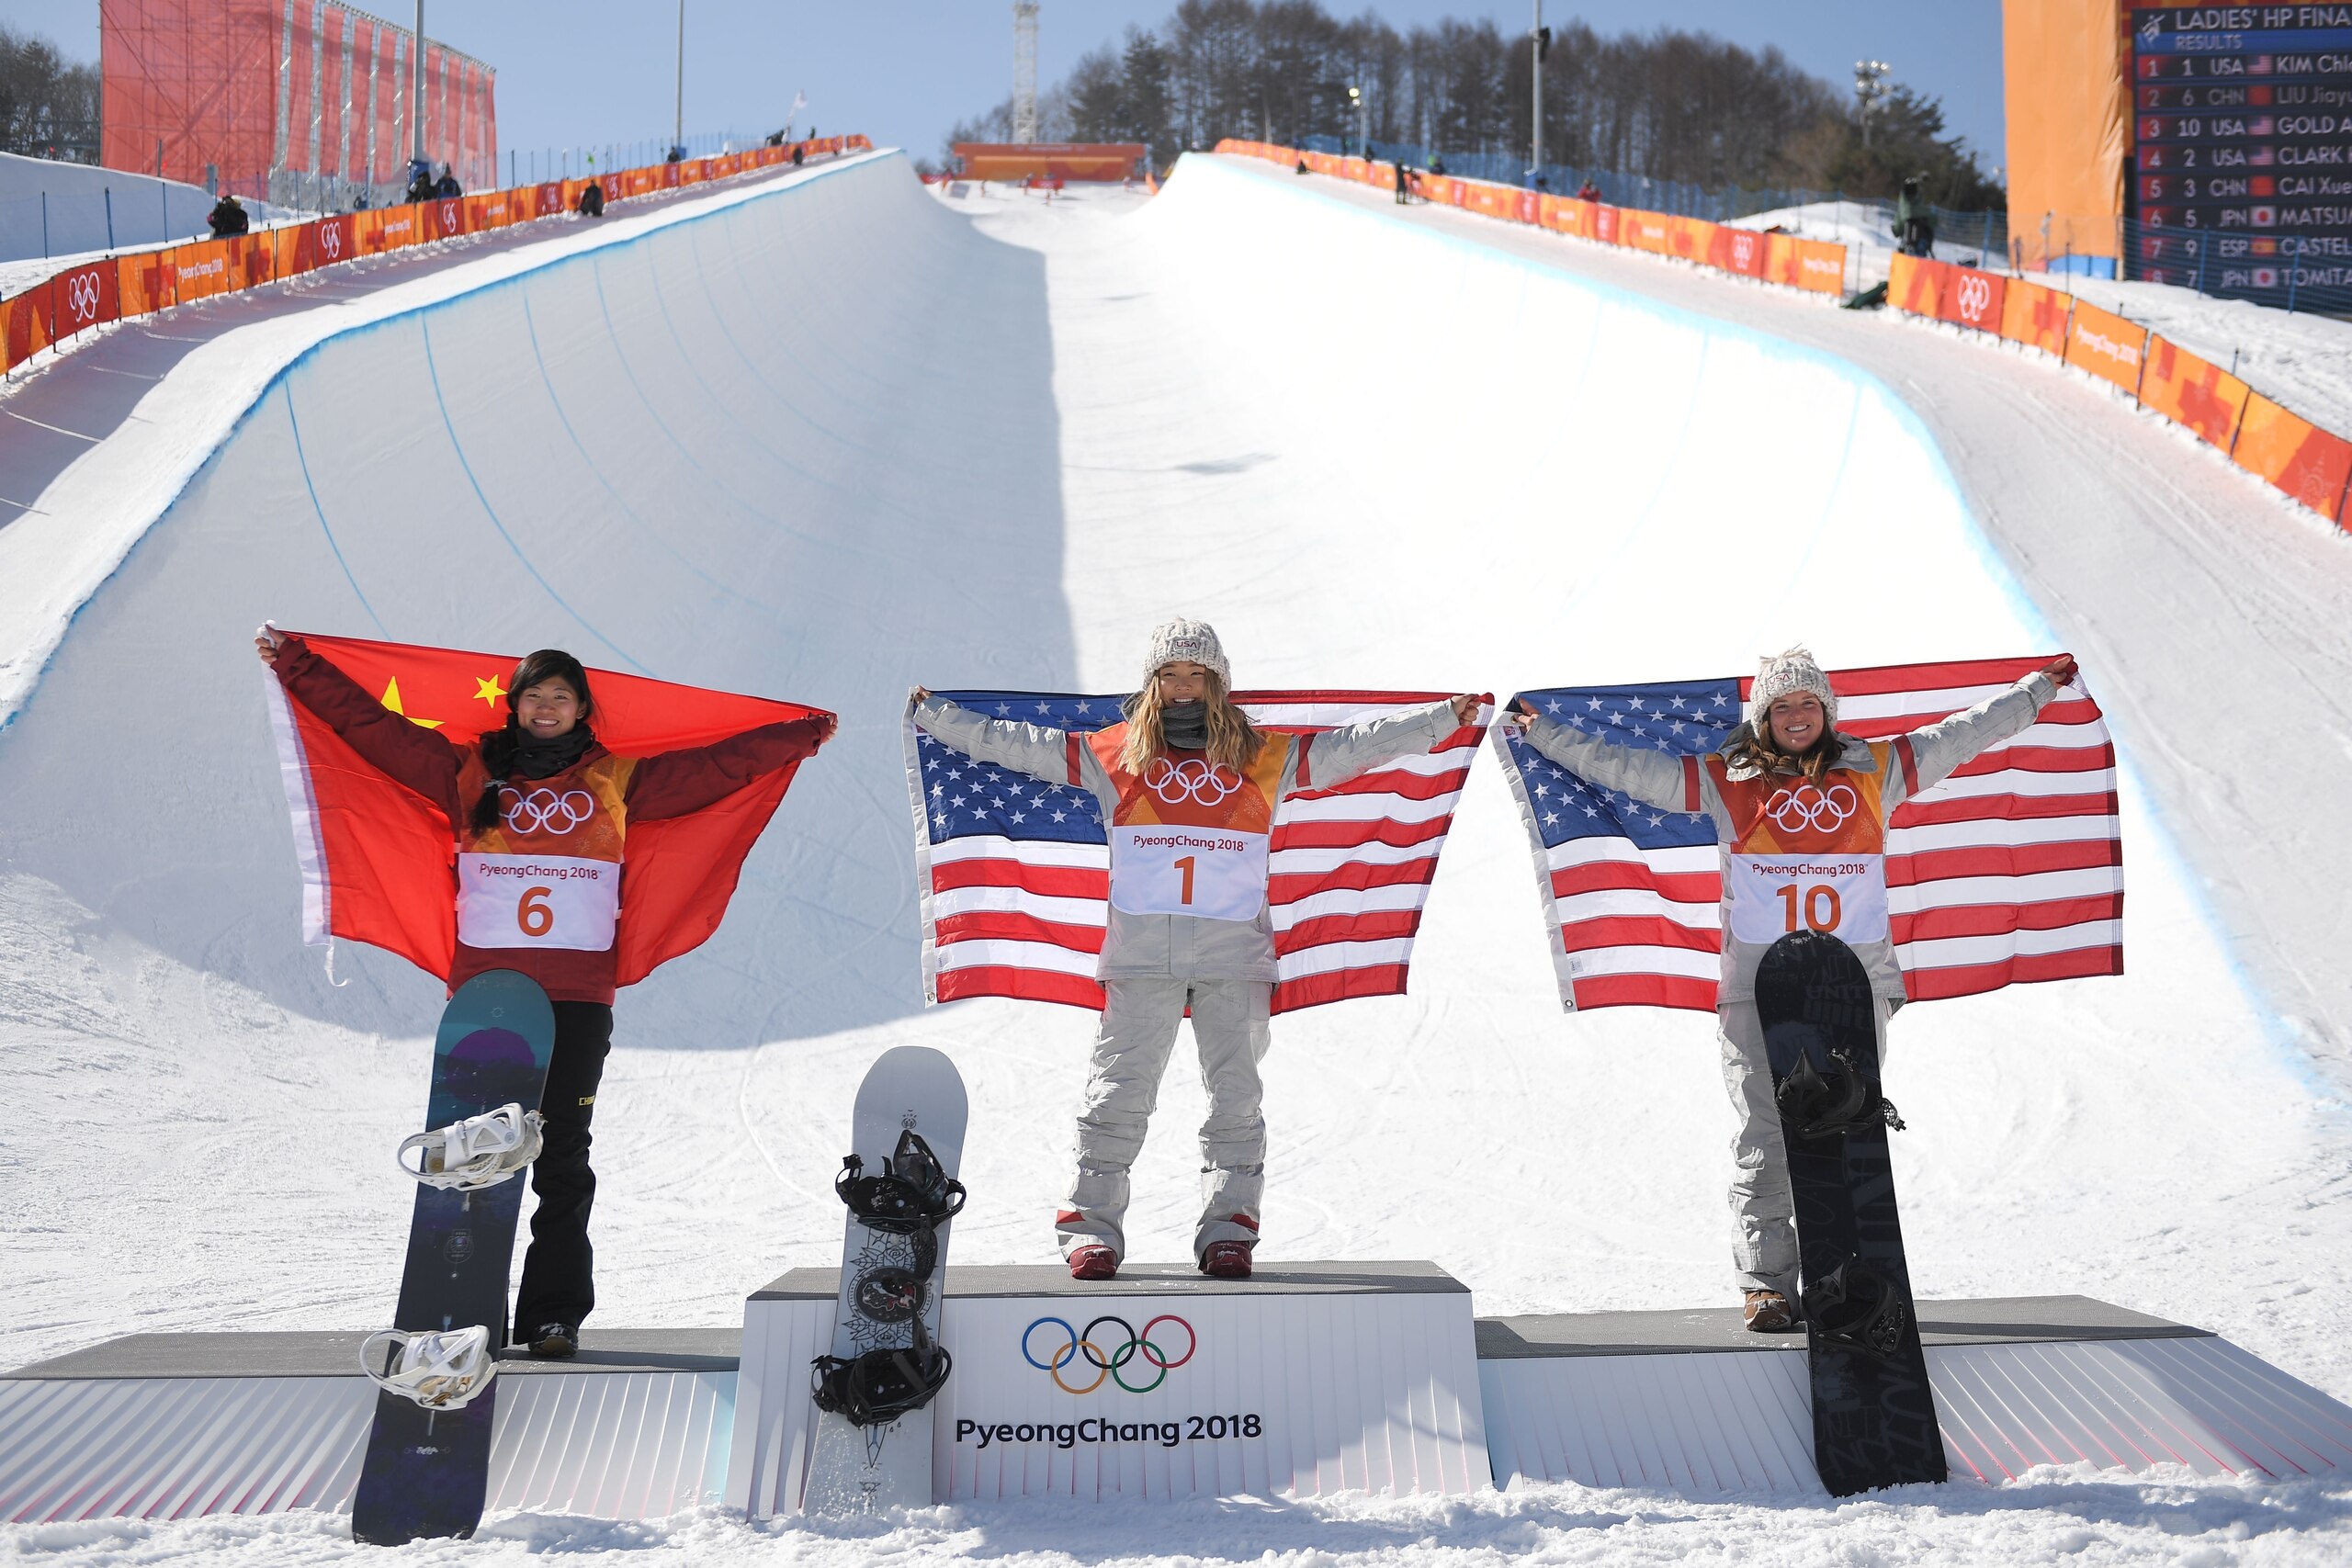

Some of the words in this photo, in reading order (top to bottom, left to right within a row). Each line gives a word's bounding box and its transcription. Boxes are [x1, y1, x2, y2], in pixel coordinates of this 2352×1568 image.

[2176, 9, 2257, 29] LADIES'
[2263, 7, 2293, 28] HP
[2175, 35, 2243, 51] RESULTS
[2147, 59, 2158, 77] 1
[2182, 59, 2193, 76] 1
[2210, 58, 2245, 75] USA
[2277, 55, 2313, 73] KIM
[2148, 89, 2159, 107] 2
[2182, 88, 2194, 107] 6
[2208, 87, 2245, 106] CHN
[2278, 86, 2307, 104] LIU
[2149, 118, 2160, 138] 3
[2177, 118, 2200, 137] 10
[2211, 118, 2245, 136] USA
[2278, 116, 2335, 134] GOLD
[2149, 150, 2161, 167] 4
[2183, 148, 2196, 167] 2
[2211, 148, 2246, 166] USA
[2278, 146, 2344, 164] CLARK
[2151, 179, 2162, 198] 5
[2184, 178, 2196, 197] 3
[2209, 178, 2247, 197] CHN
[2278, 176, 2314, 196] CAI
[2151, 209, 2162, 228] 6
[2185, 209, 2197, 228] 5
[2218, 209, 2247, 227] JPN
[2151, 240, 2162, 259] 7
[2185, 240, 2197, 258] 9
[2219, 240, 2248, 257] ESP
[2220, 269, 2249, 288] JPN
[1176, 640, 1198, 649] USA
[1769, 673, 1791, 684] USA
[1133, 835, 1216, 852] PyeongChang
[1217, 838, 1244, 852] 2018
[479, 863, 568, 880] PyeongChang
[570, 866, 598, 880] 2018
[1174, 856, 1194, 905] 1
[1752, 863, 1838, 877] PyeongChang
[1838, 863, 1866, 874] 2018
[517, 886, 553, 937] 6
[1776, 884, 1842, 933] 10
[956, 1418, 1180, 1449] PyeongChang
[1186, 1414, 1261, 1439] 2018
